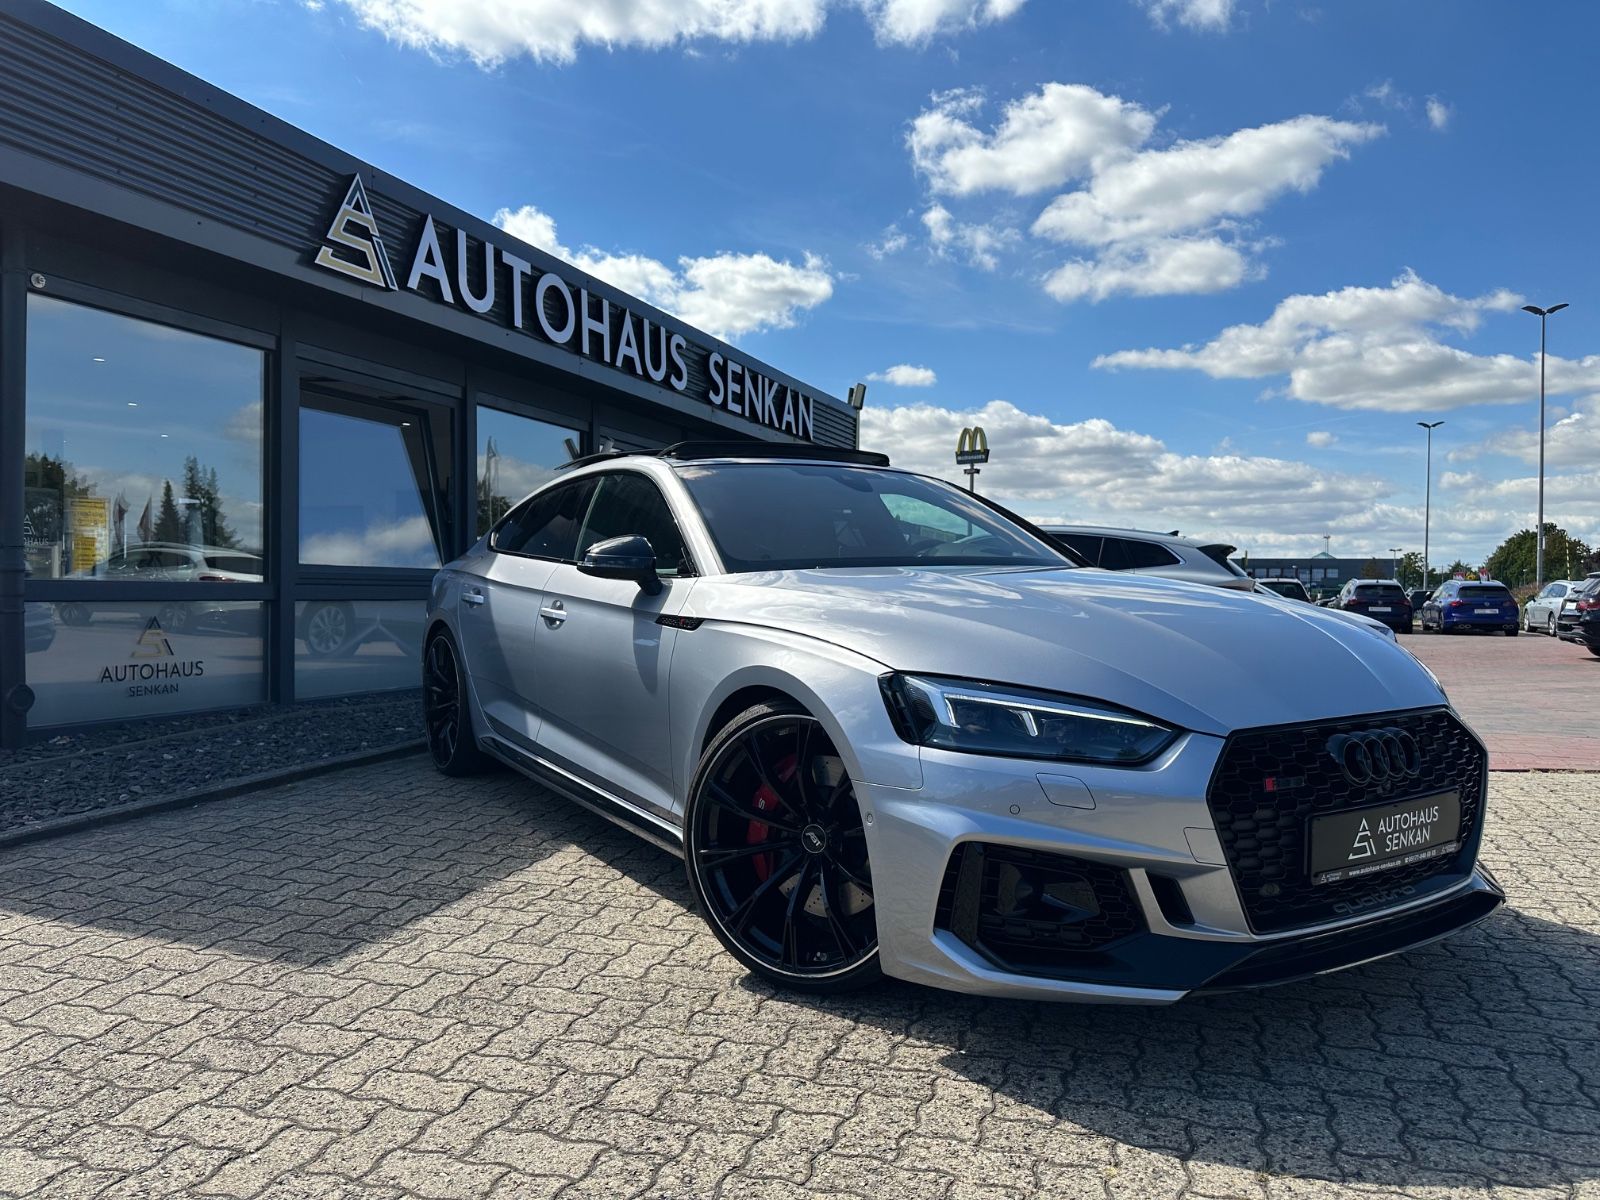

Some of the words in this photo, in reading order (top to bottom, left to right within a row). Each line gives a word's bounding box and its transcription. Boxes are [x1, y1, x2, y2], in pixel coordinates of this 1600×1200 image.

[407, 213, 689, 391] AUTOHAUS
[708, 352, 814, 442] SENKAN
[100, 661, 204, 683] AUTOHAUS
[128, 683, 179, 697] SENKAN
[1378, 806, 1439, 834] AUTOHAUS
[1385, 825, 1431, 852] SENKAN
[1333, 885, 1417, 914] quattro
